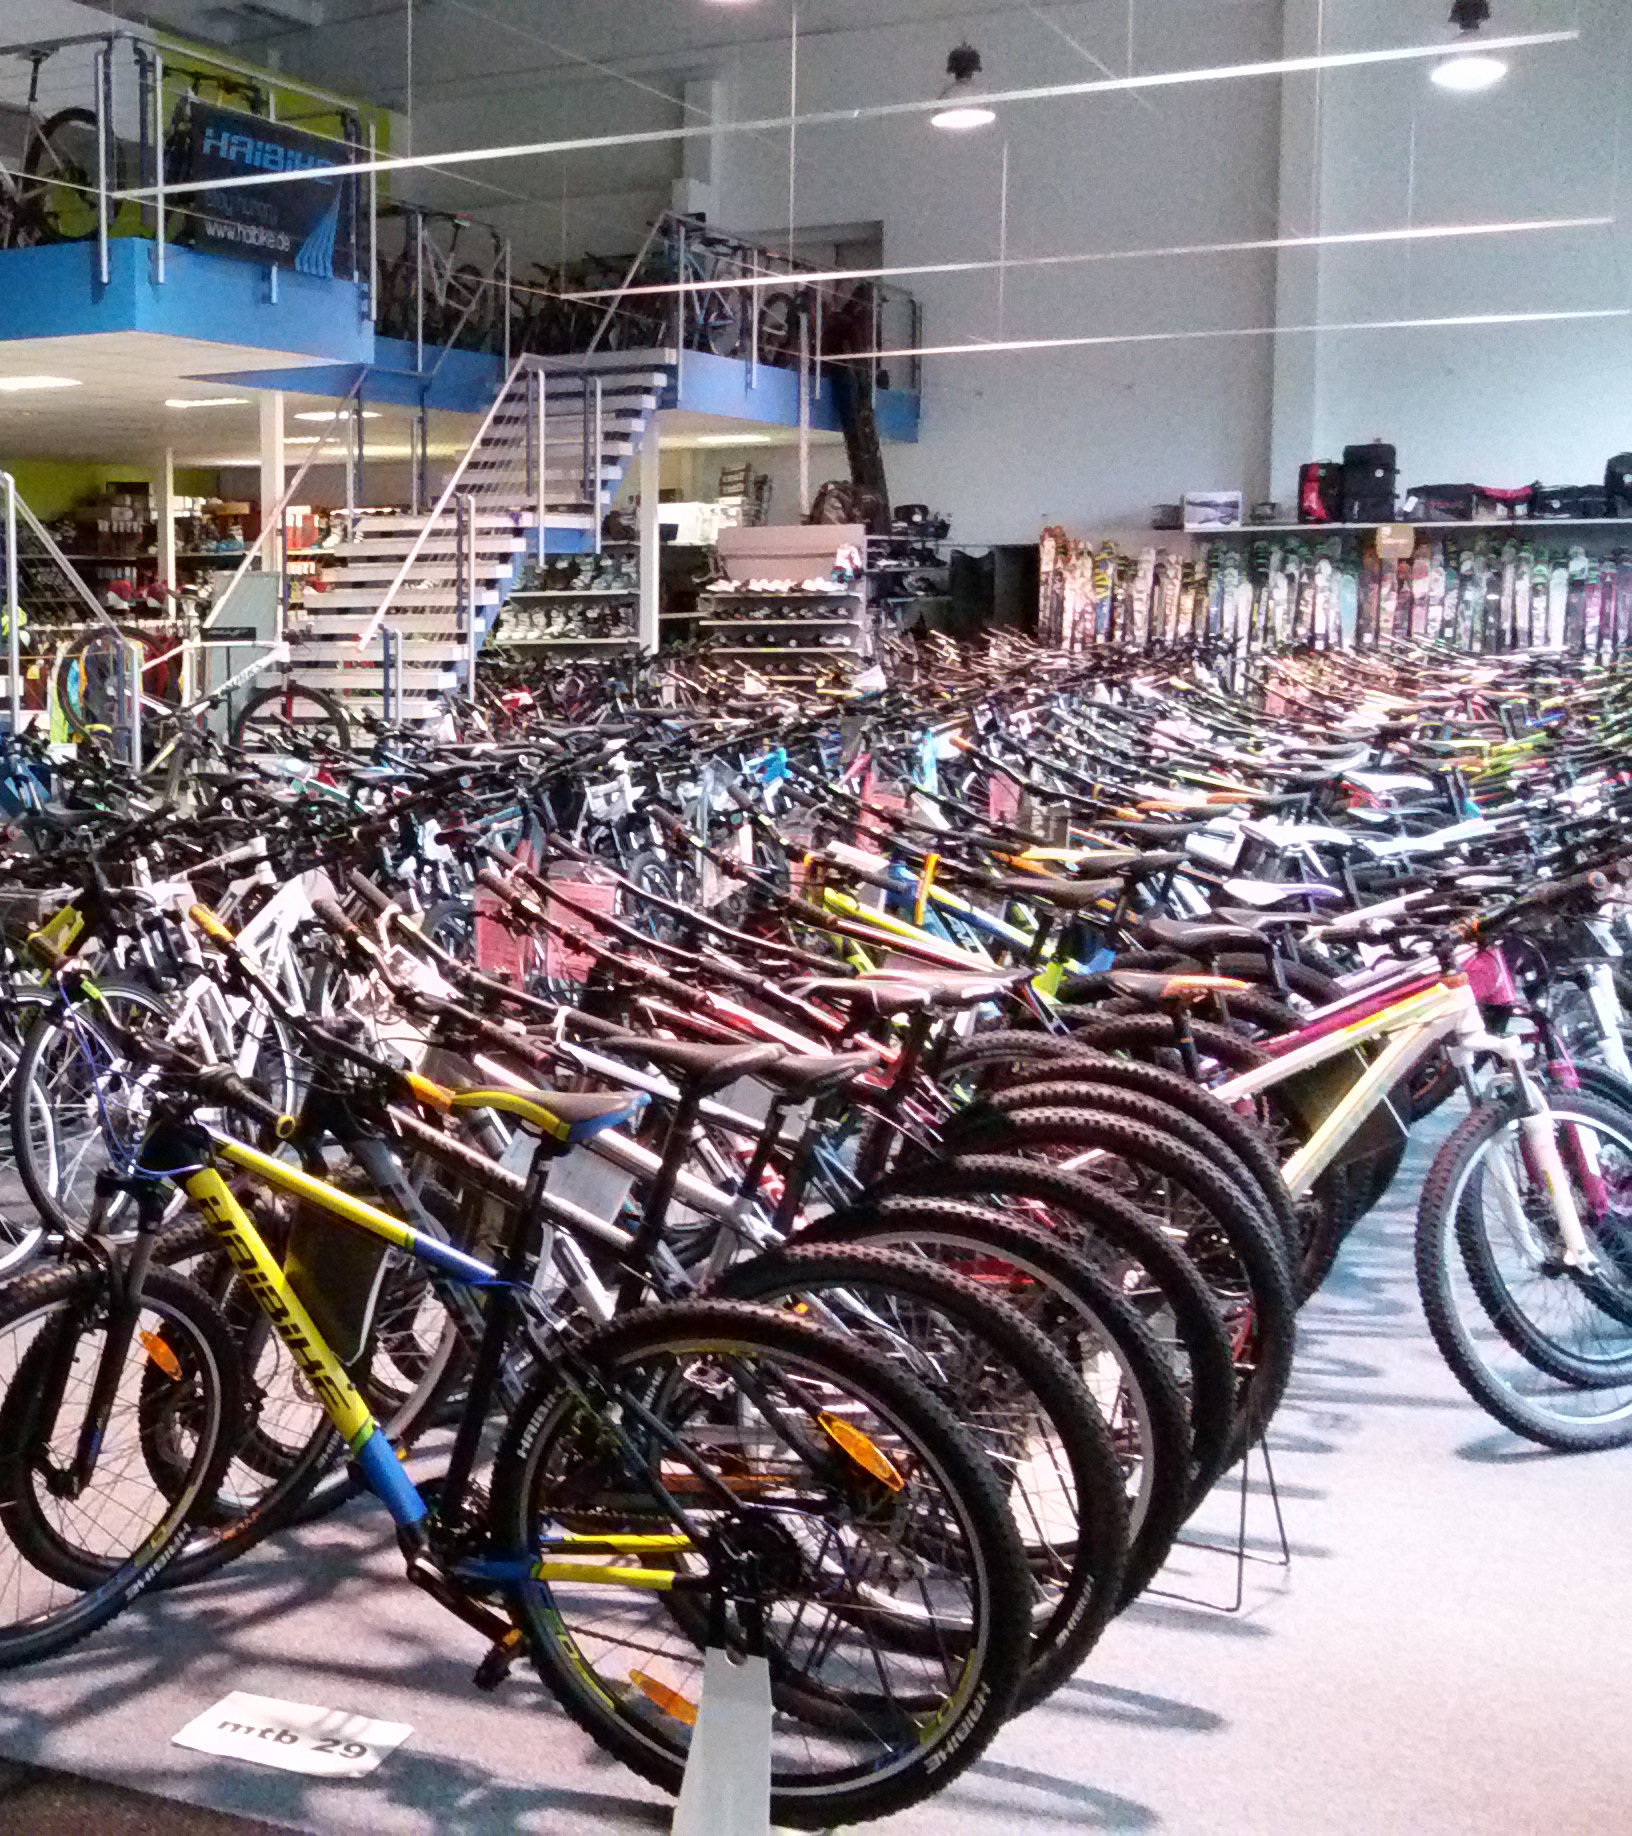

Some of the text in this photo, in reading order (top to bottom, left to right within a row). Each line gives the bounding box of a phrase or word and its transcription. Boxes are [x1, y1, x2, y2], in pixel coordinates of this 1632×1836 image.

[200, 1196, 351, 1413] HAIBIKE
[217, 1720, 368, 1759] mtb 29
